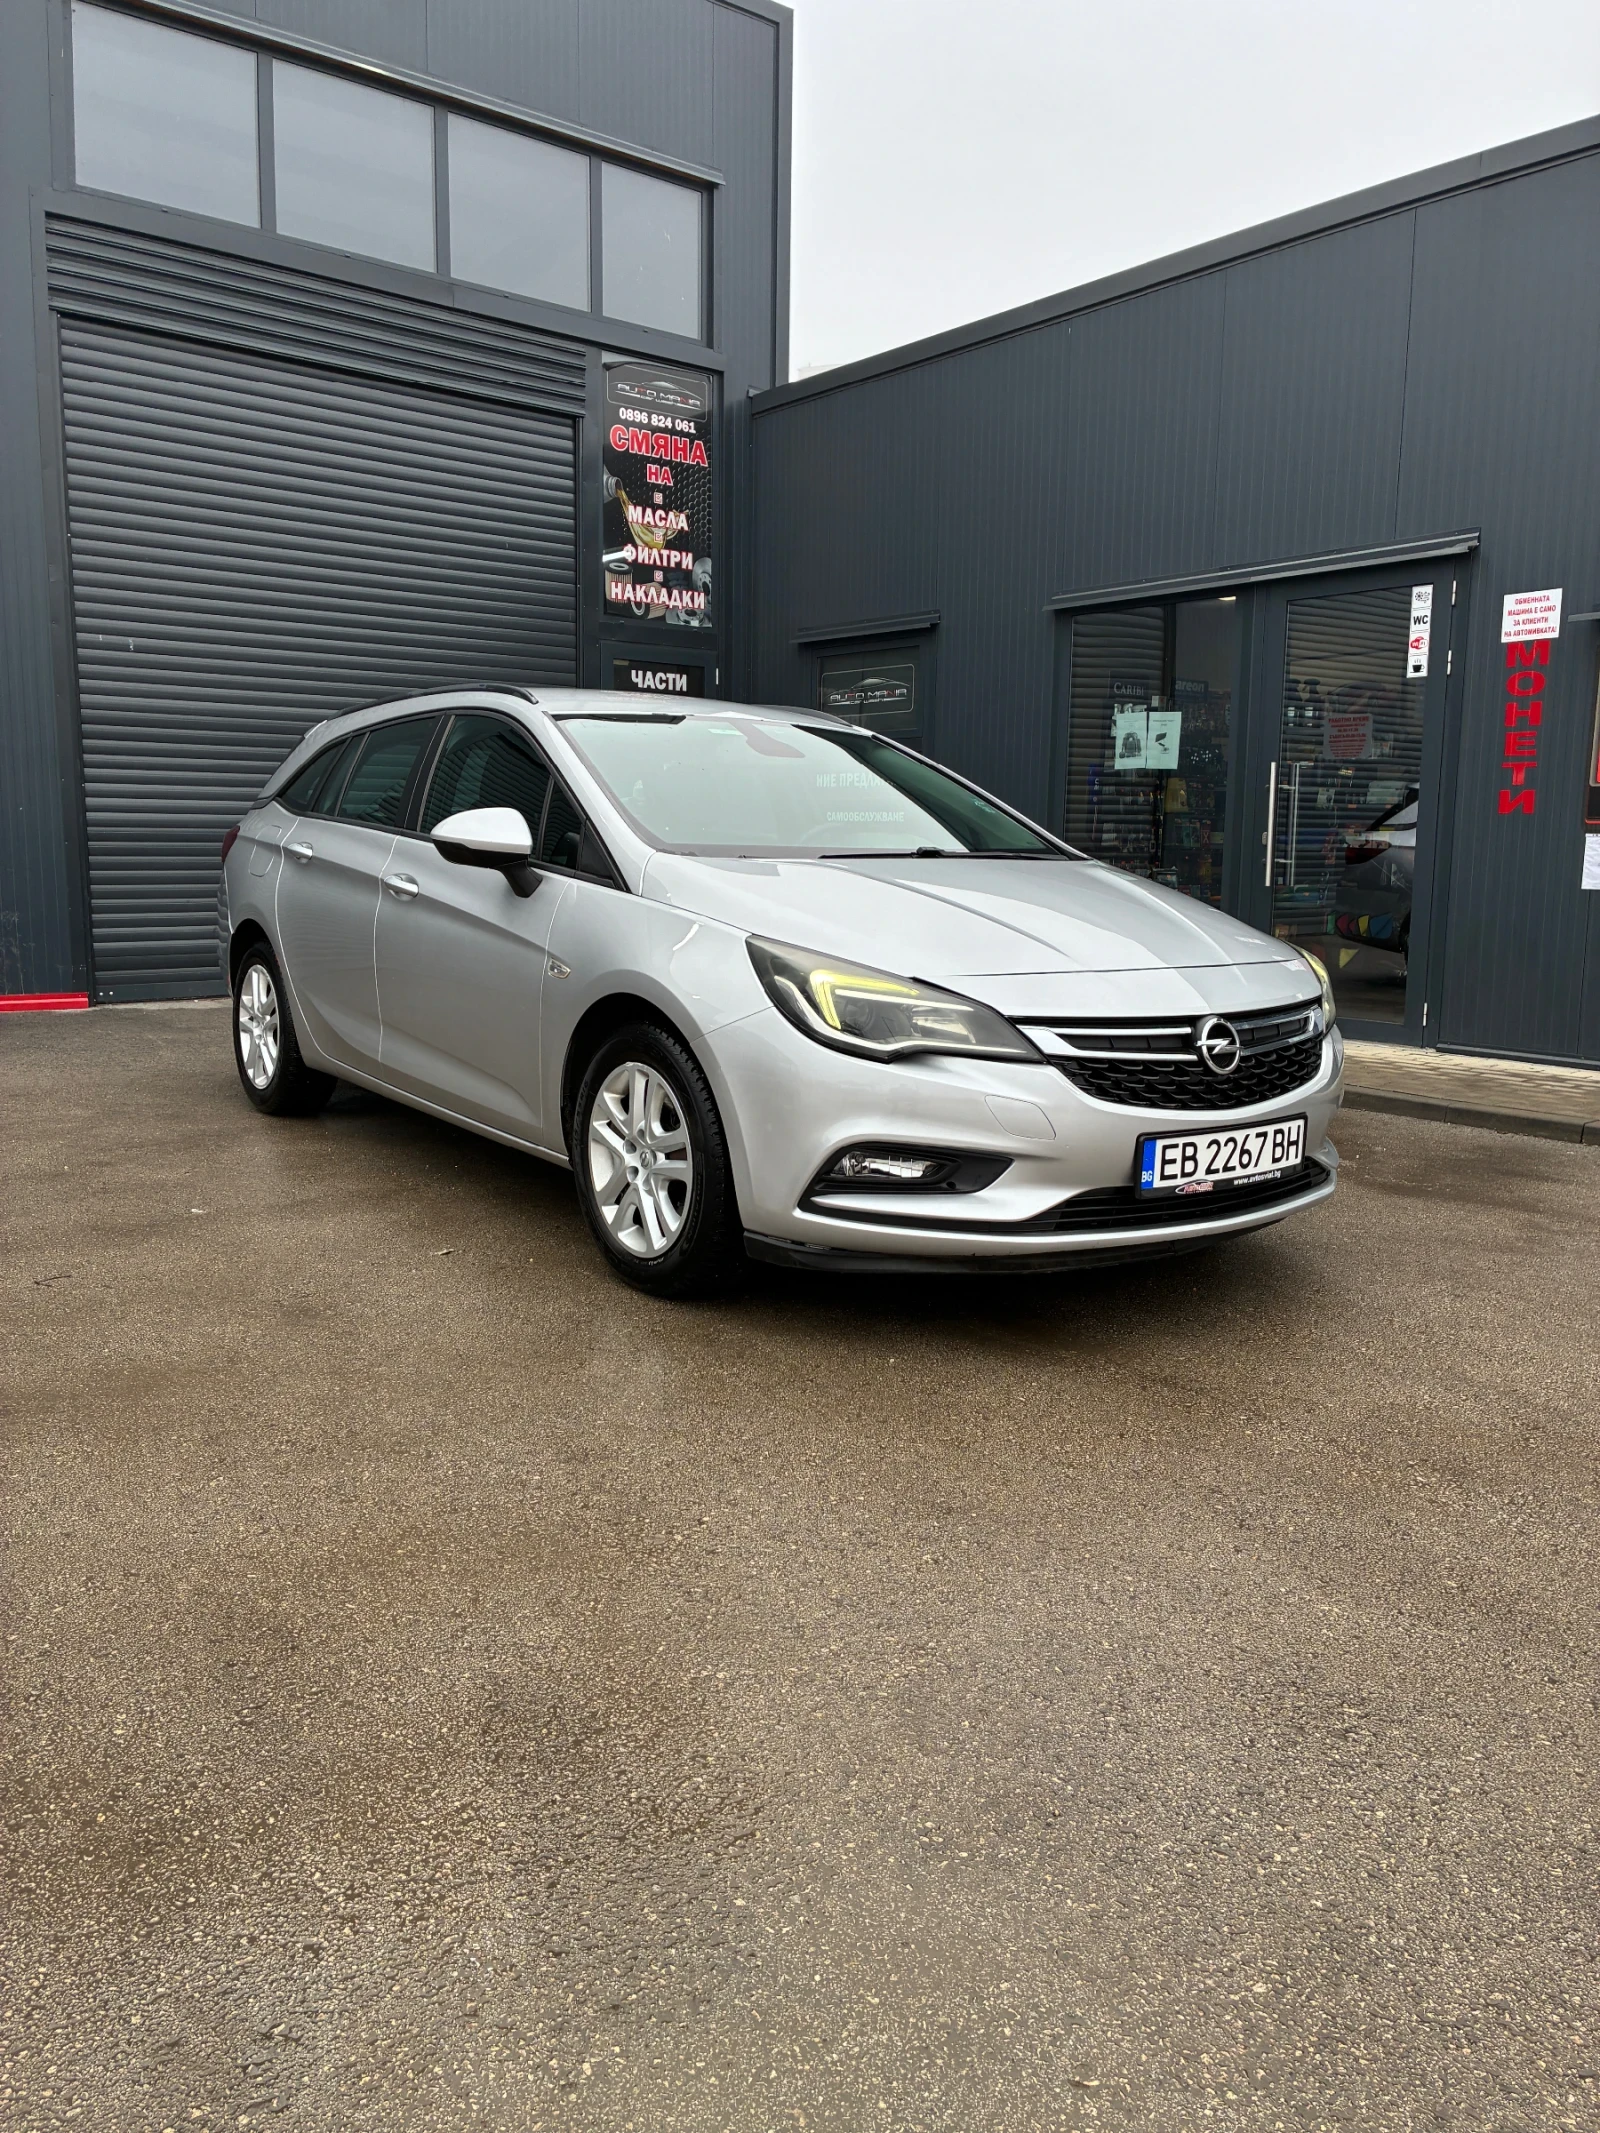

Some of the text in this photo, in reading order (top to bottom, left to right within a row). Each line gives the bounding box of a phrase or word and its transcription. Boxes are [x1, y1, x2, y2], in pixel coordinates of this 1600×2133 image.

[619, 407, 696, 434] 0896 824 061
[609, 424, 709, 468] СМЯНА
[646, 463, 673, 487] НА
[627, 504, 689, 532] МАСЛА
[623, 546, 694, 571] ФИЛТРИ
[610, 581, 705, 611] НАКЛАДКИ
[1507, 604, 1556, 616] МАШИНА Е САМО
[1413, 615, 1428, 625] WC
[1513, 616, 1549, 627] ЗА КЛИЕНТИ
[1504, 630, 1512, 638] НА
[631, 668, 687, 692] ЧАСТИ
[1175, 680, 1204, 693] areon
[830, 688, 907, 702] AUTO MANIA
[1498, 641, 1551, 815] МОНЕТИ
[816, 773, 837, 787] НИЕ
[826, 811, 905, 822] САМООБСЛУЖВАНЕ
[1159, 1124, 1301, 1182] EB 2267 BH
[1141, 1170, 1153, 1183] BG
